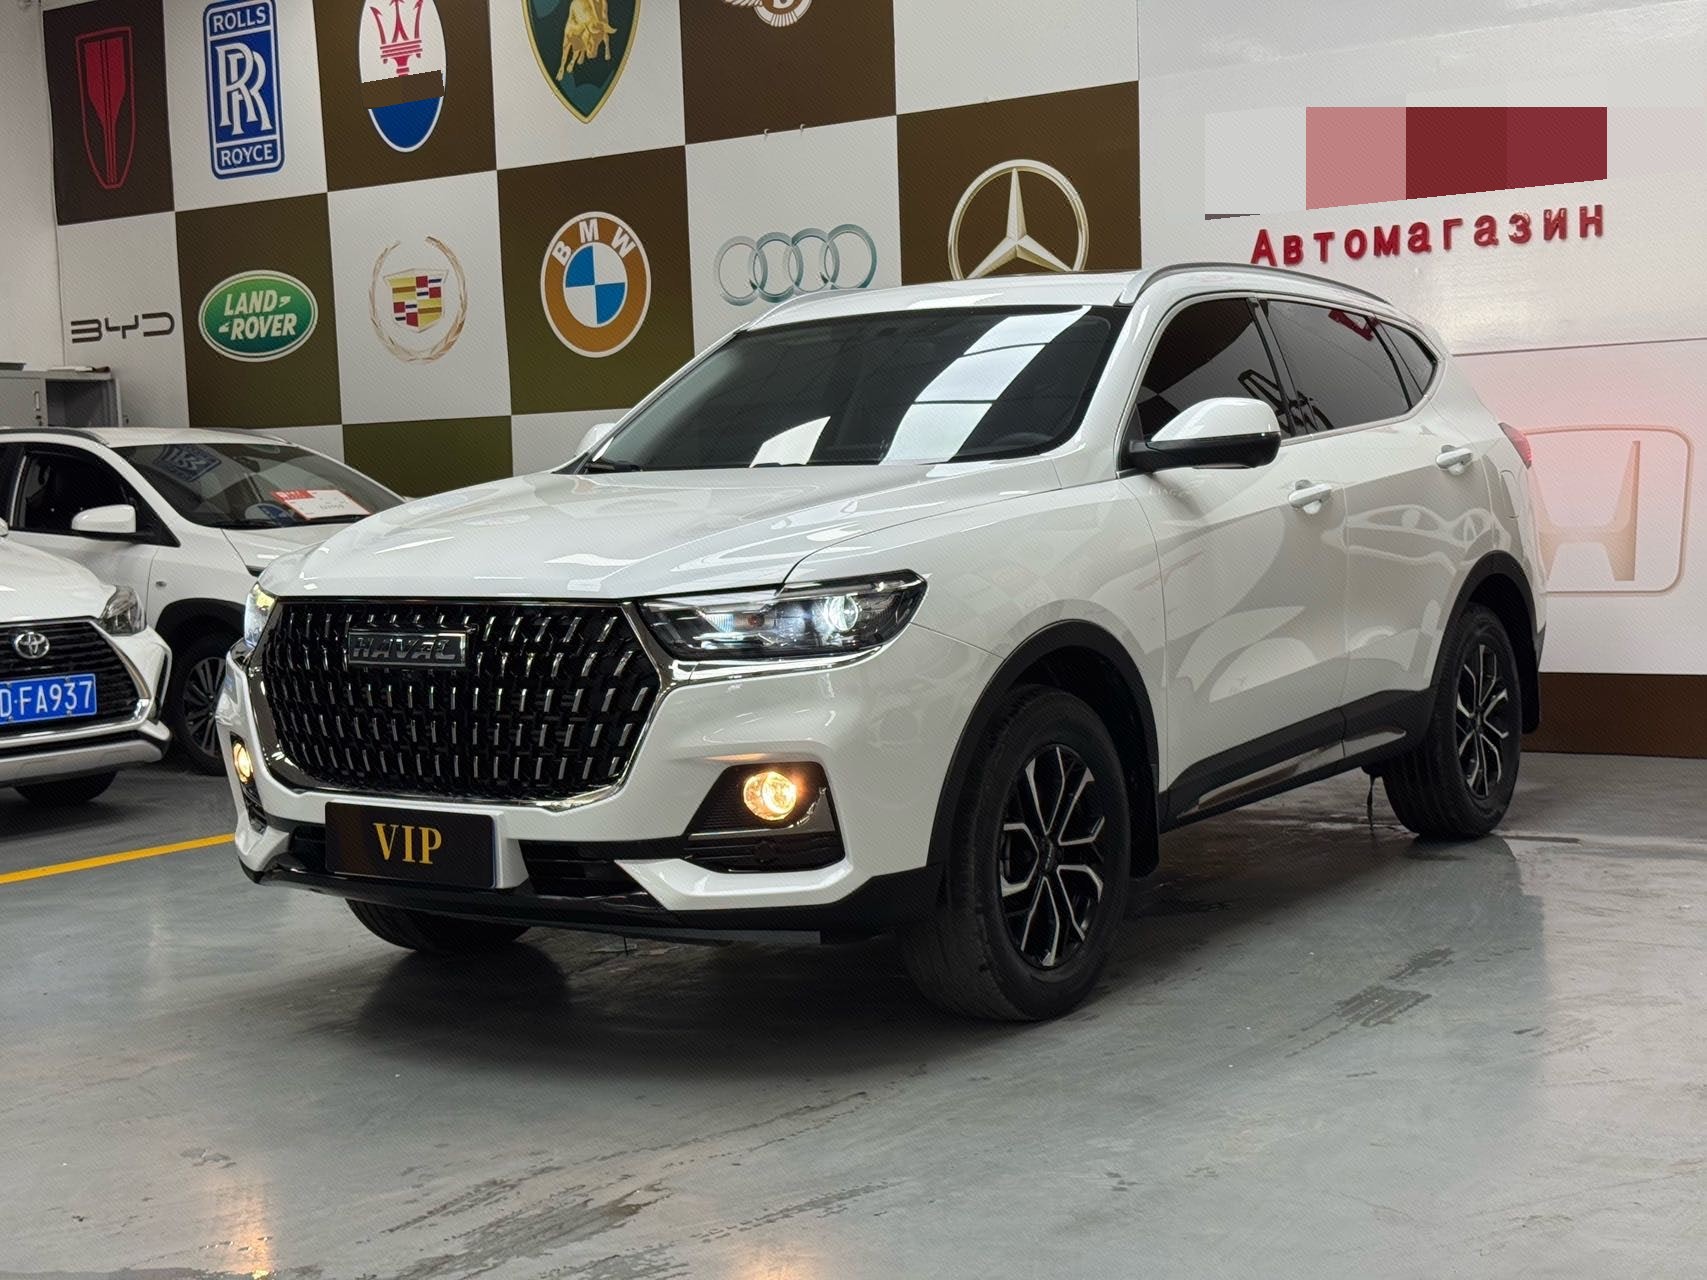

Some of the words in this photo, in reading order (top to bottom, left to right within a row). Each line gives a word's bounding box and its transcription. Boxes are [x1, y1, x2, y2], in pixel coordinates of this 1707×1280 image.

[213, 6, 268, 33] ROLLS
[221, 143, 274, 167] ROYCE
[552, 218, 637, 266] BMW
[1251, 204, 1604, 267] Автомагазин
[224, 289, 278, 317] LAND
[71, 311, 175, 344] BYD
[230, 312, 298, 341] ROVER
[373, 822, 442, 865] VIP
